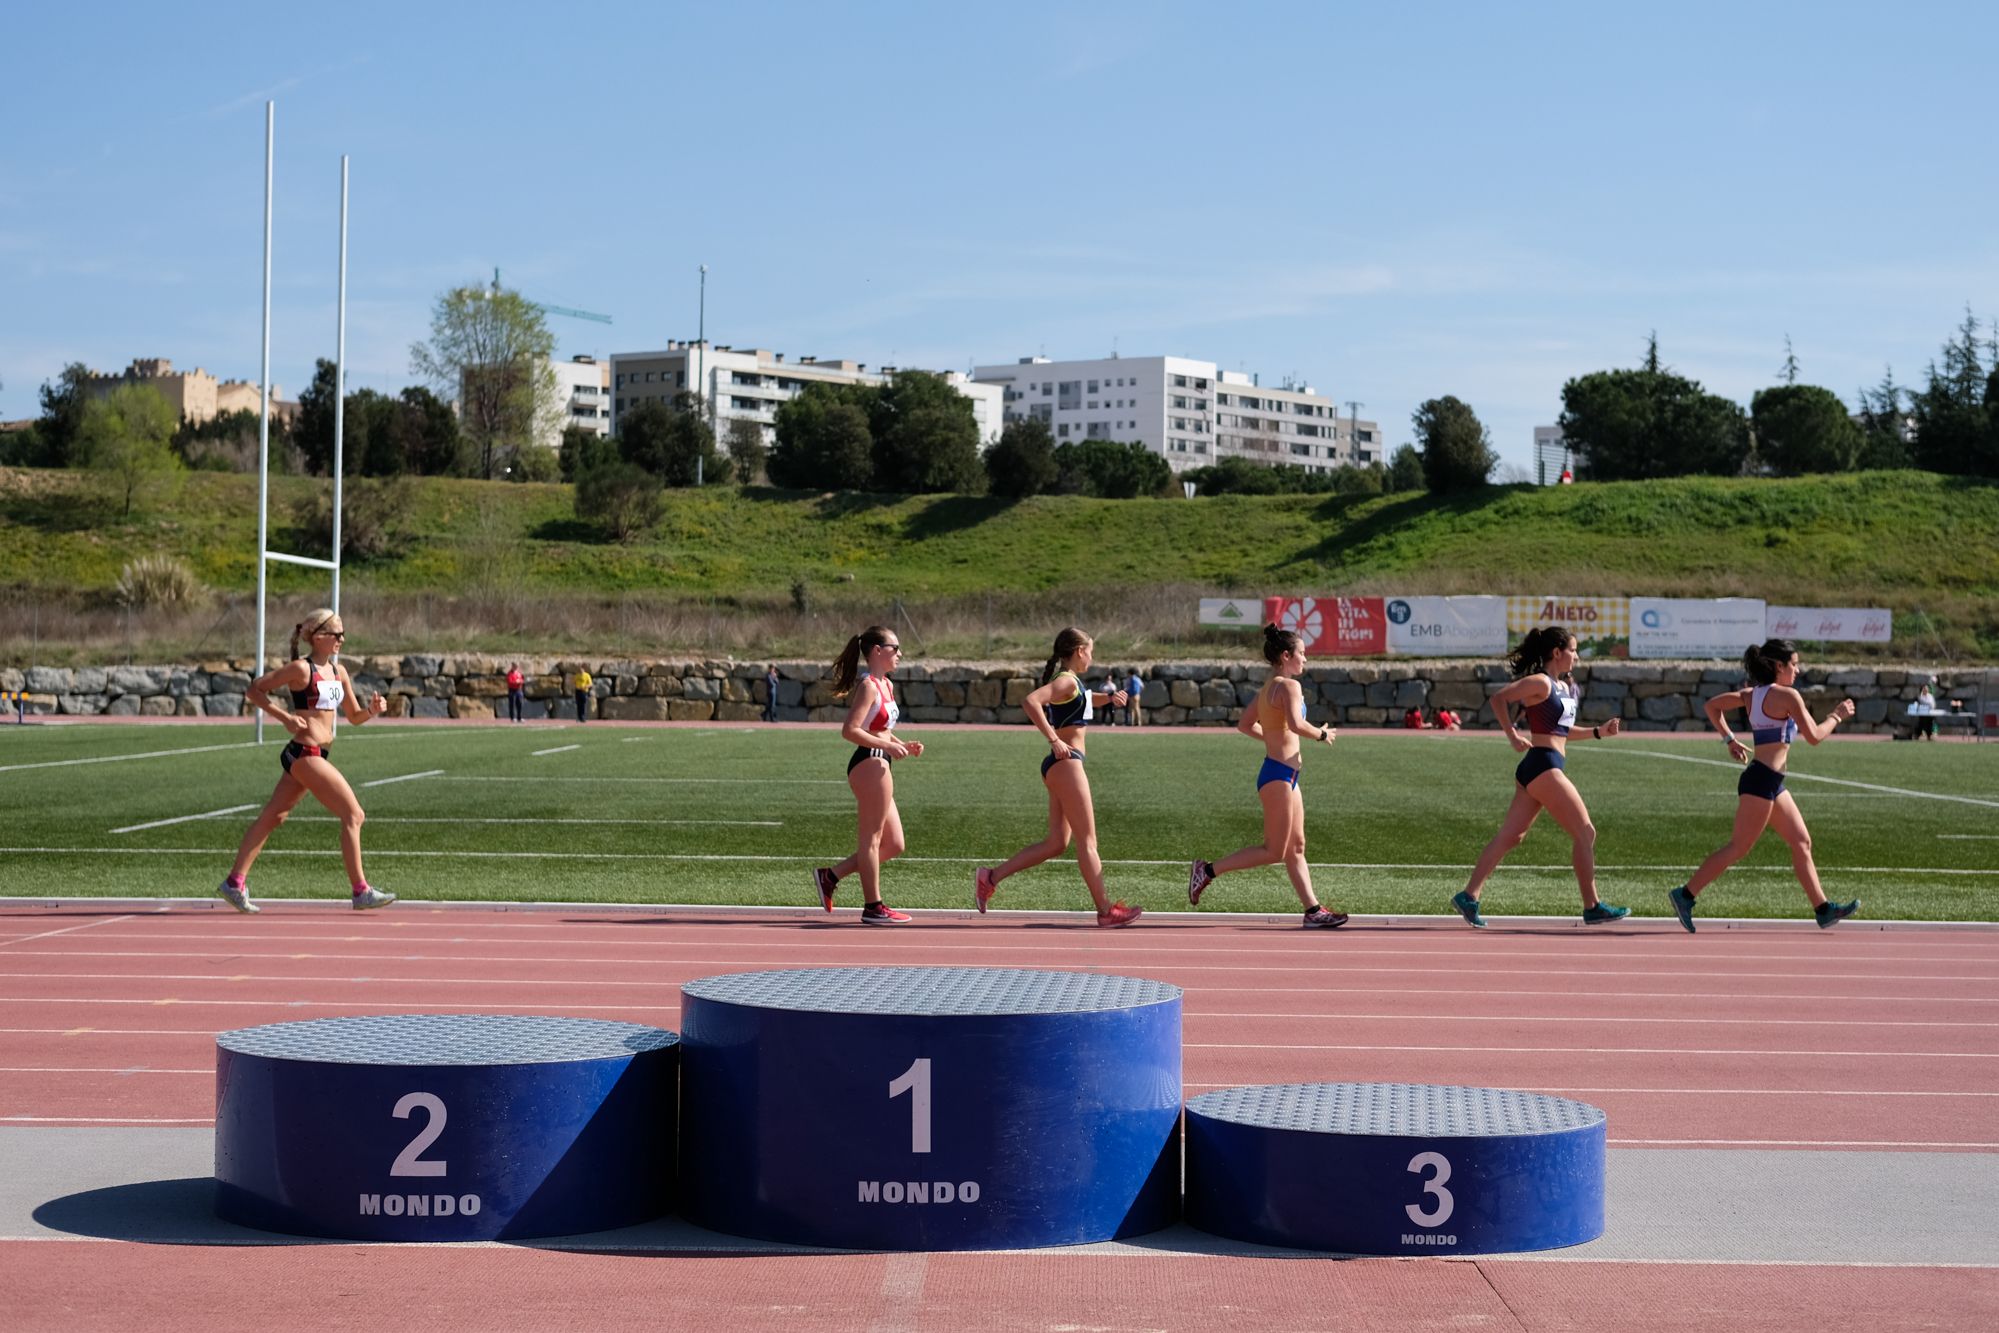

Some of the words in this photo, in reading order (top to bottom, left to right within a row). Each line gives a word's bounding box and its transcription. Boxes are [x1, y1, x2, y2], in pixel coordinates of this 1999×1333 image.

[329, 687, 340, 701] 30
[889, 1058, 931, 1153] 1
[389, 1091, 447, 1177] 2
[858, 1181, 980, 1203] MONDO
[1405, 1151, 1454, 1228] 3
[359, 1193, 481, 1216] MONDO
[1401, 1234, 1457, 1245] MONDO
